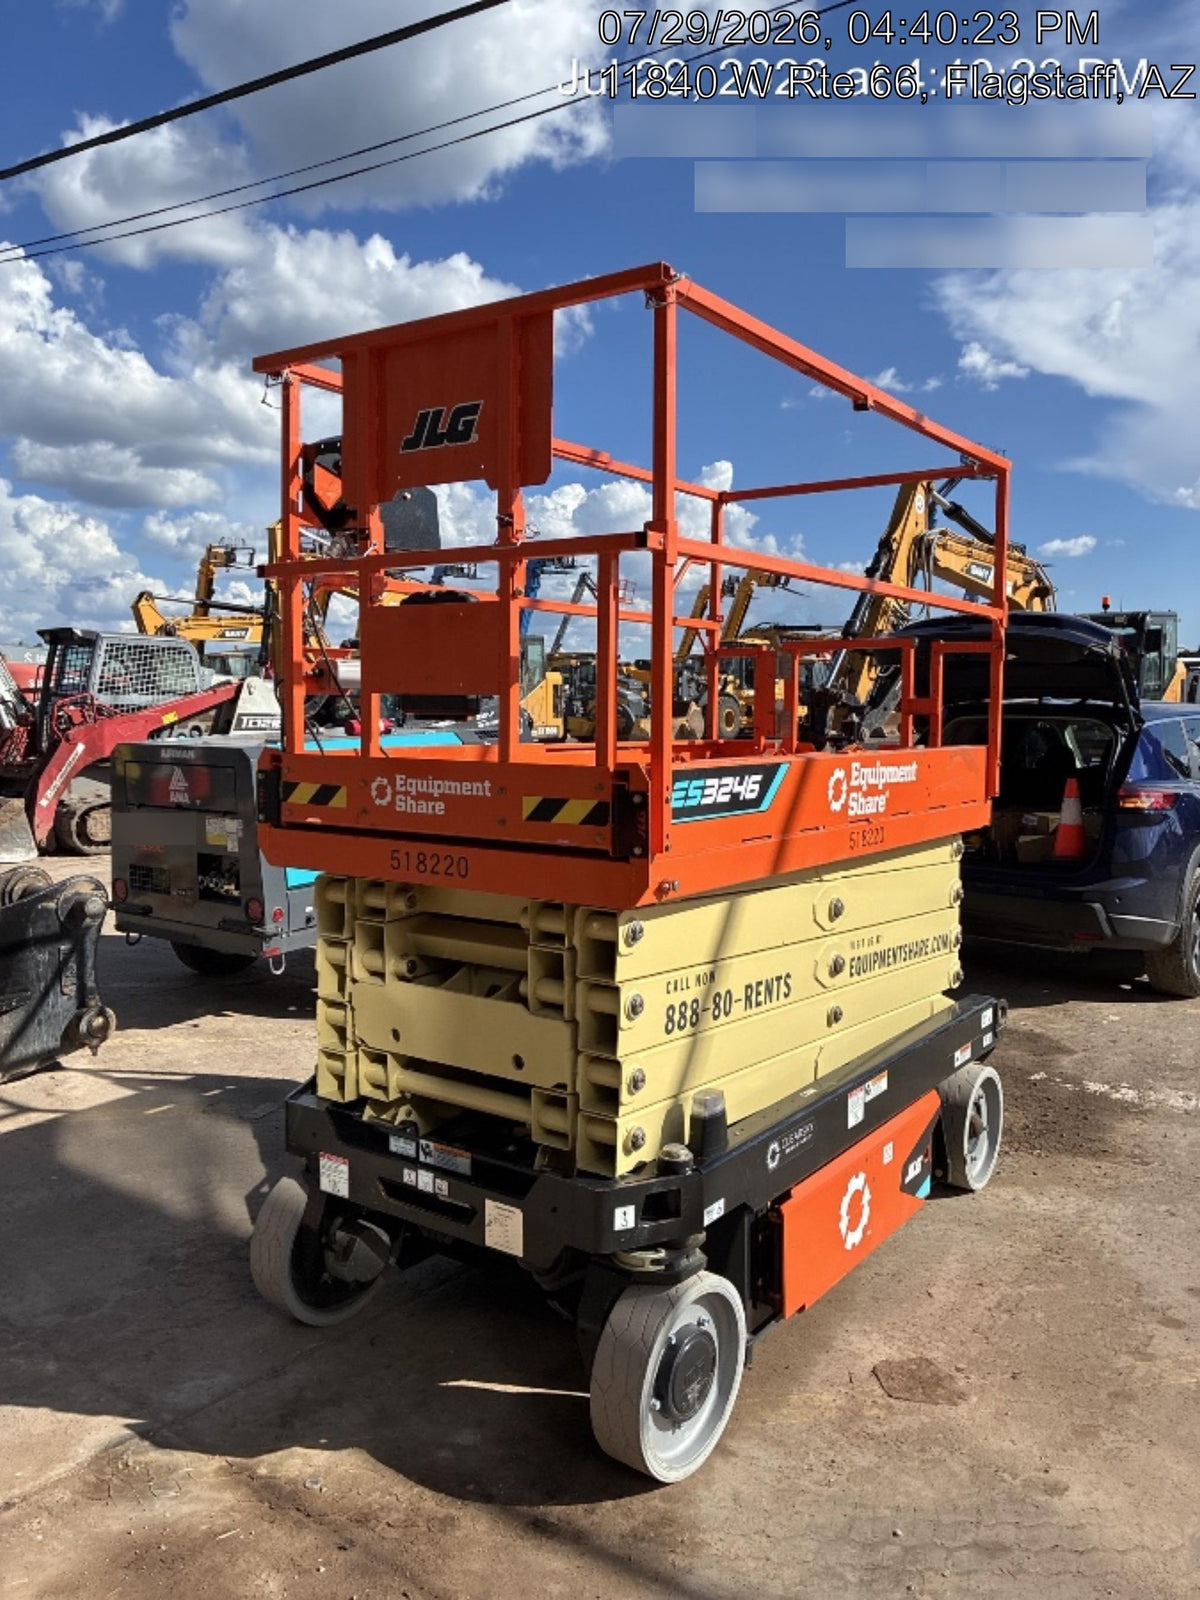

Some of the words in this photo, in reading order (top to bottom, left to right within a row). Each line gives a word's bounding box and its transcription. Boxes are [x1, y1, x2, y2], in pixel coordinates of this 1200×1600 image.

[400, 400, 484, 454] JLG
[395, 774, 492, 798] Equipment
[671, 774, 764, 808] ES3246
[850, 760, 919, 792] Equipment
[395, 794, 446, 815] Share
[847, 792, 886, 817] Share
[390, 849, 469, 879] 518220
[849, 933, 949, 978] EQUIPMENTSHARE.COM
[666, 976, 691, 994] CALL
[695, 970, 716, 987] NOW
[664, 972, 792, 1035] 888-80-RENTS
